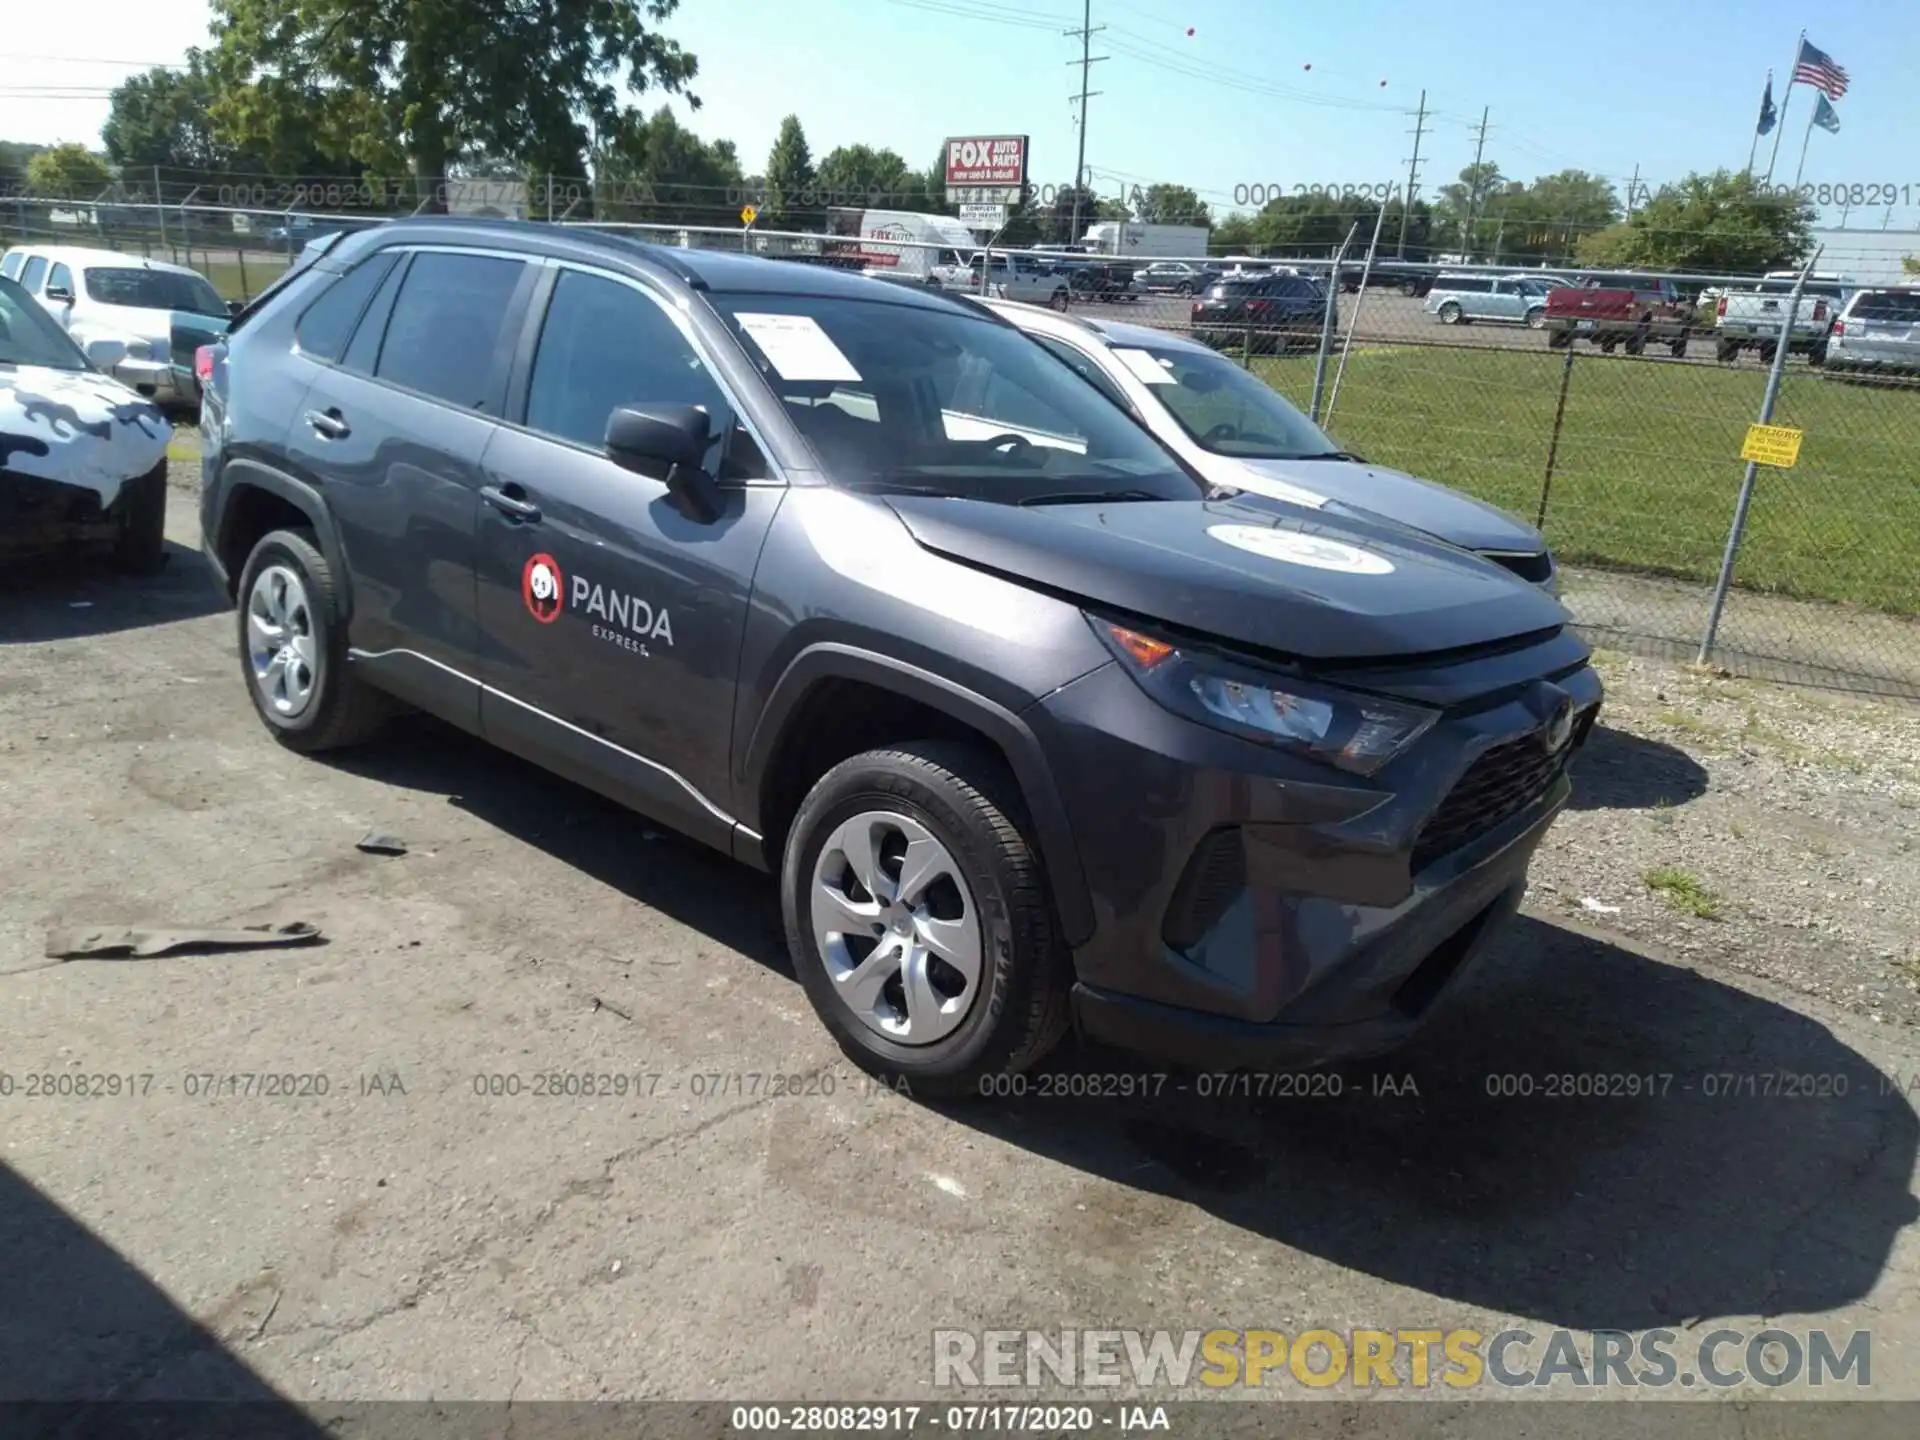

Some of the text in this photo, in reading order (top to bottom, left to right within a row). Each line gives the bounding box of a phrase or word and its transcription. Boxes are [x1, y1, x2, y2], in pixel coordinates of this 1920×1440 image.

[950, 141, 992, 168] FOX
[993, 141, 1018, 153] AUTO
[992, 155, 1020, 167] PARTS
[571, 574, 674, 646] PANDA
[592, 624, 648, 656] EXPRESS
